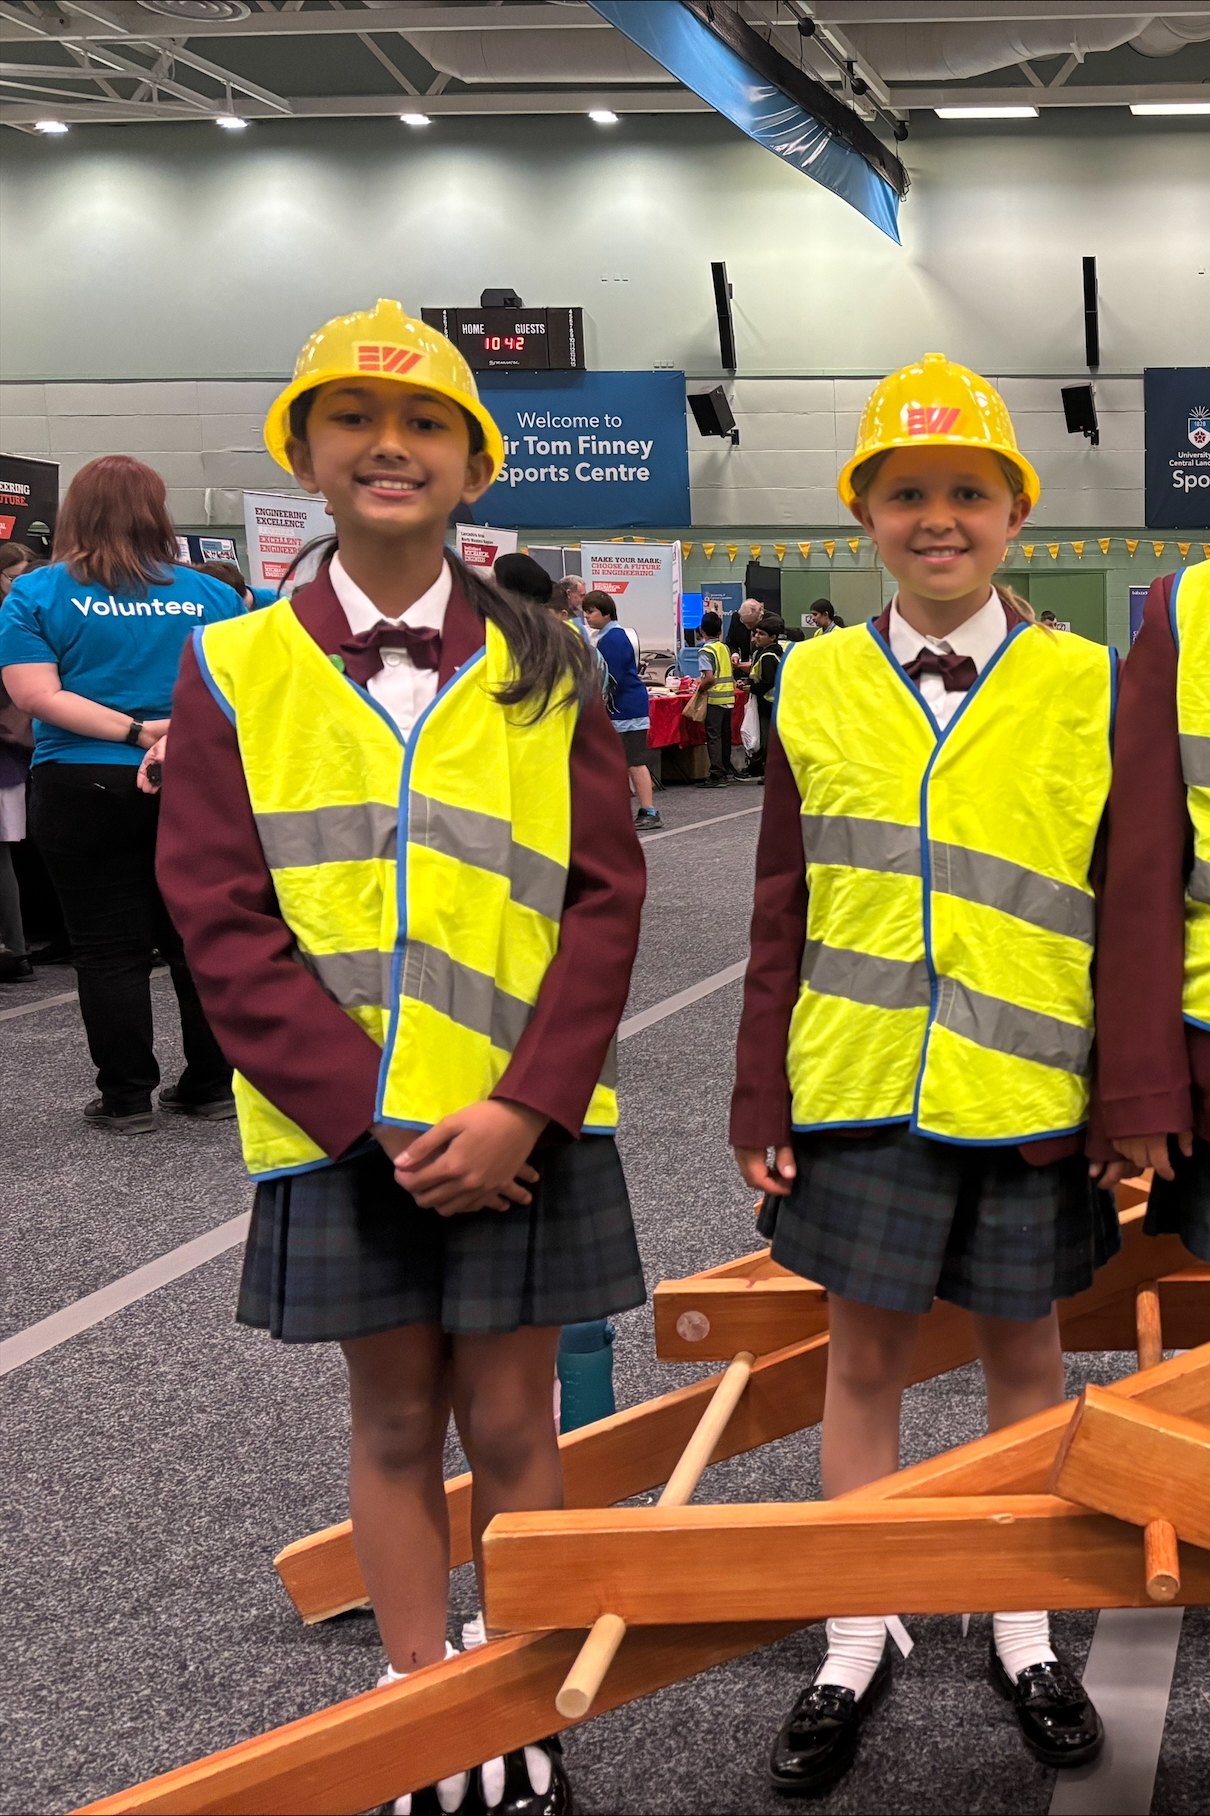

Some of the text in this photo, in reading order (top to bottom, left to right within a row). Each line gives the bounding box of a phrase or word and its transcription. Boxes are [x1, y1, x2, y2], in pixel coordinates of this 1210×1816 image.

[462, 323, 485, 335] HOME
[515, 323, 545, 335] GUESTS
[517, 411, 622, 428] Welcome to
[503, 435, 653, 460] ir Tom Finney
[1169, 459, 1194, 467] Central
[496, 462, 650, 487] Sports Centre
[255, 507, 307, 520] ENGINEERING
[256, 517, 305, 529] EXCELLENCE
[259, 535, 303, 546] EXCELLENT
[71, 596, 204, 617] Volunteer
